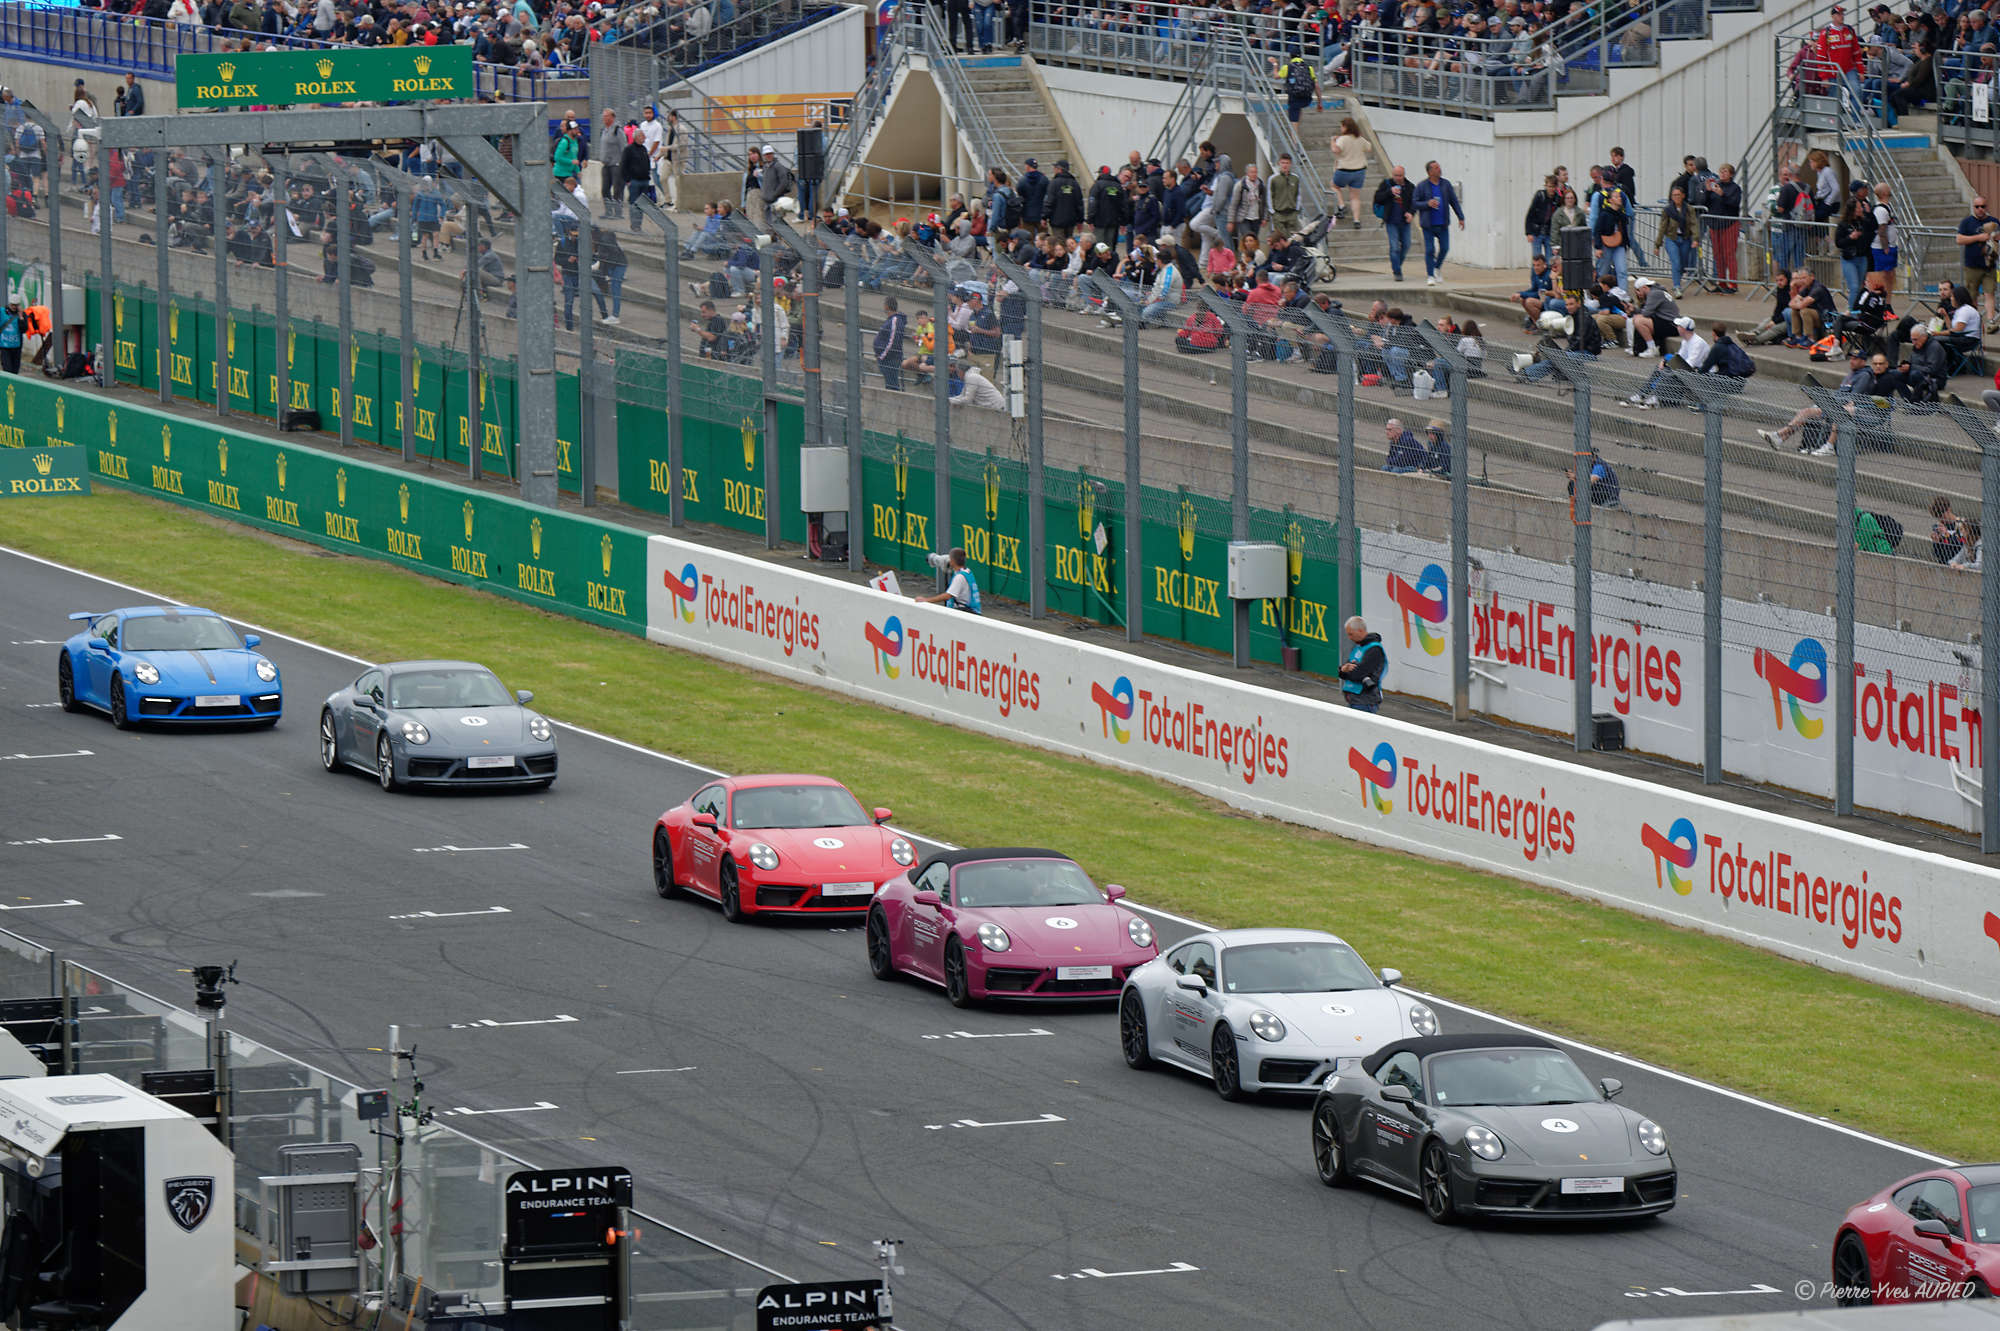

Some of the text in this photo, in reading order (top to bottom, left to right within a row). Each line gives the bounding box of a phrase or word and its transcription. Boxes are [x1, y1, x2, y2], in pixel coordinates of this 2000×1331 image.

[197, 84, 258, 99] ROLEX
[295, 81, 356, 95] ROLEX
[393, 77, 455, 92] ROLEX
[114, 339, 137, 370] LEX
[156, 348, 193, 385] LEX
[269, 374, 310, 410] RLEX
[395, 400, 436, 442] RLEX
[98, 450, 130, 480] ROLEX
[152, 464, 184, 495] ROLEX
[649, 458, 700, 503] ROEX
[10, 477, 83, 494] ROLEX
[208, 480, 241, 511] ROLEX
[723, 477, 767, 521] ROLE
[266, 495, 300, 527] ROLEX
[325, 511, 360, 543] ROLEX
[873, 503, 929, 551] ROLEX
[387, 527, 423, 560] ROLEX
[451, 545, 488, 578] ROLEX
[518, 562, 556, 597] ROLEX
[701, 573, 819, 657] TotalEnergies
[907, 627, 1040, 717] TotalEnergies
[1138, 688, 1288, 785] TotalEnergies
[1402, 757, 1576, 862] TotalEnergies
[1704, 833, 1902, 950] TotalEnergies
[1376, 1112, 1411, 1134] PORSCHE
[520, 1198, 586, 1210] ENDURANCE
[1908, 1250, 1948, 1276] PORSCHE
[772, 1312, 876, 1327] ENDURANCE TEAM
